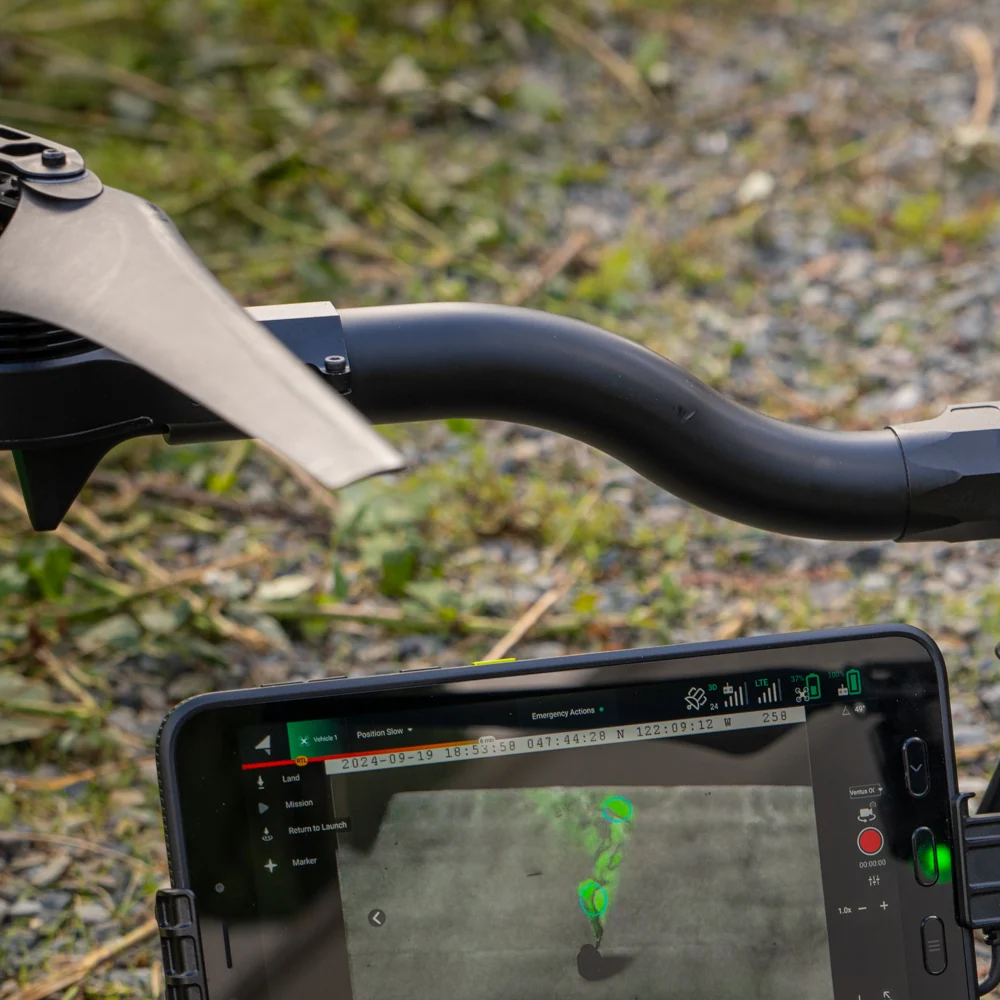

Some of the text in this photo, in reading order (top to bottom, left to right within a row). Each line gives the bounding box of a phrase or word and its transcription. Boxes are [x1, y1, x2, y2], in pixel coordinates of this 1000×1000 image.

[755, 679, 768, 687] LTE
[532, 707, 595, 720] Emergency Actions
[357, 728, 404, 739] Position Slow
[313, 734, 333, 743] Vehicle
[342, 710, 787, 770] 2024-09-19 18:53:58 047:44:28 N 122:09:12 W 258
[282, 774, 300, 783] Land
[850, 787, 867, 796] Ventus
[286, 800, 313, 809] Mission
[288, 825, 312, 835] Return
[322, 821, 347, 831] Launch
[292, 858, 317, 866] Marker
[838, 906, 852, 914] 1.0x
